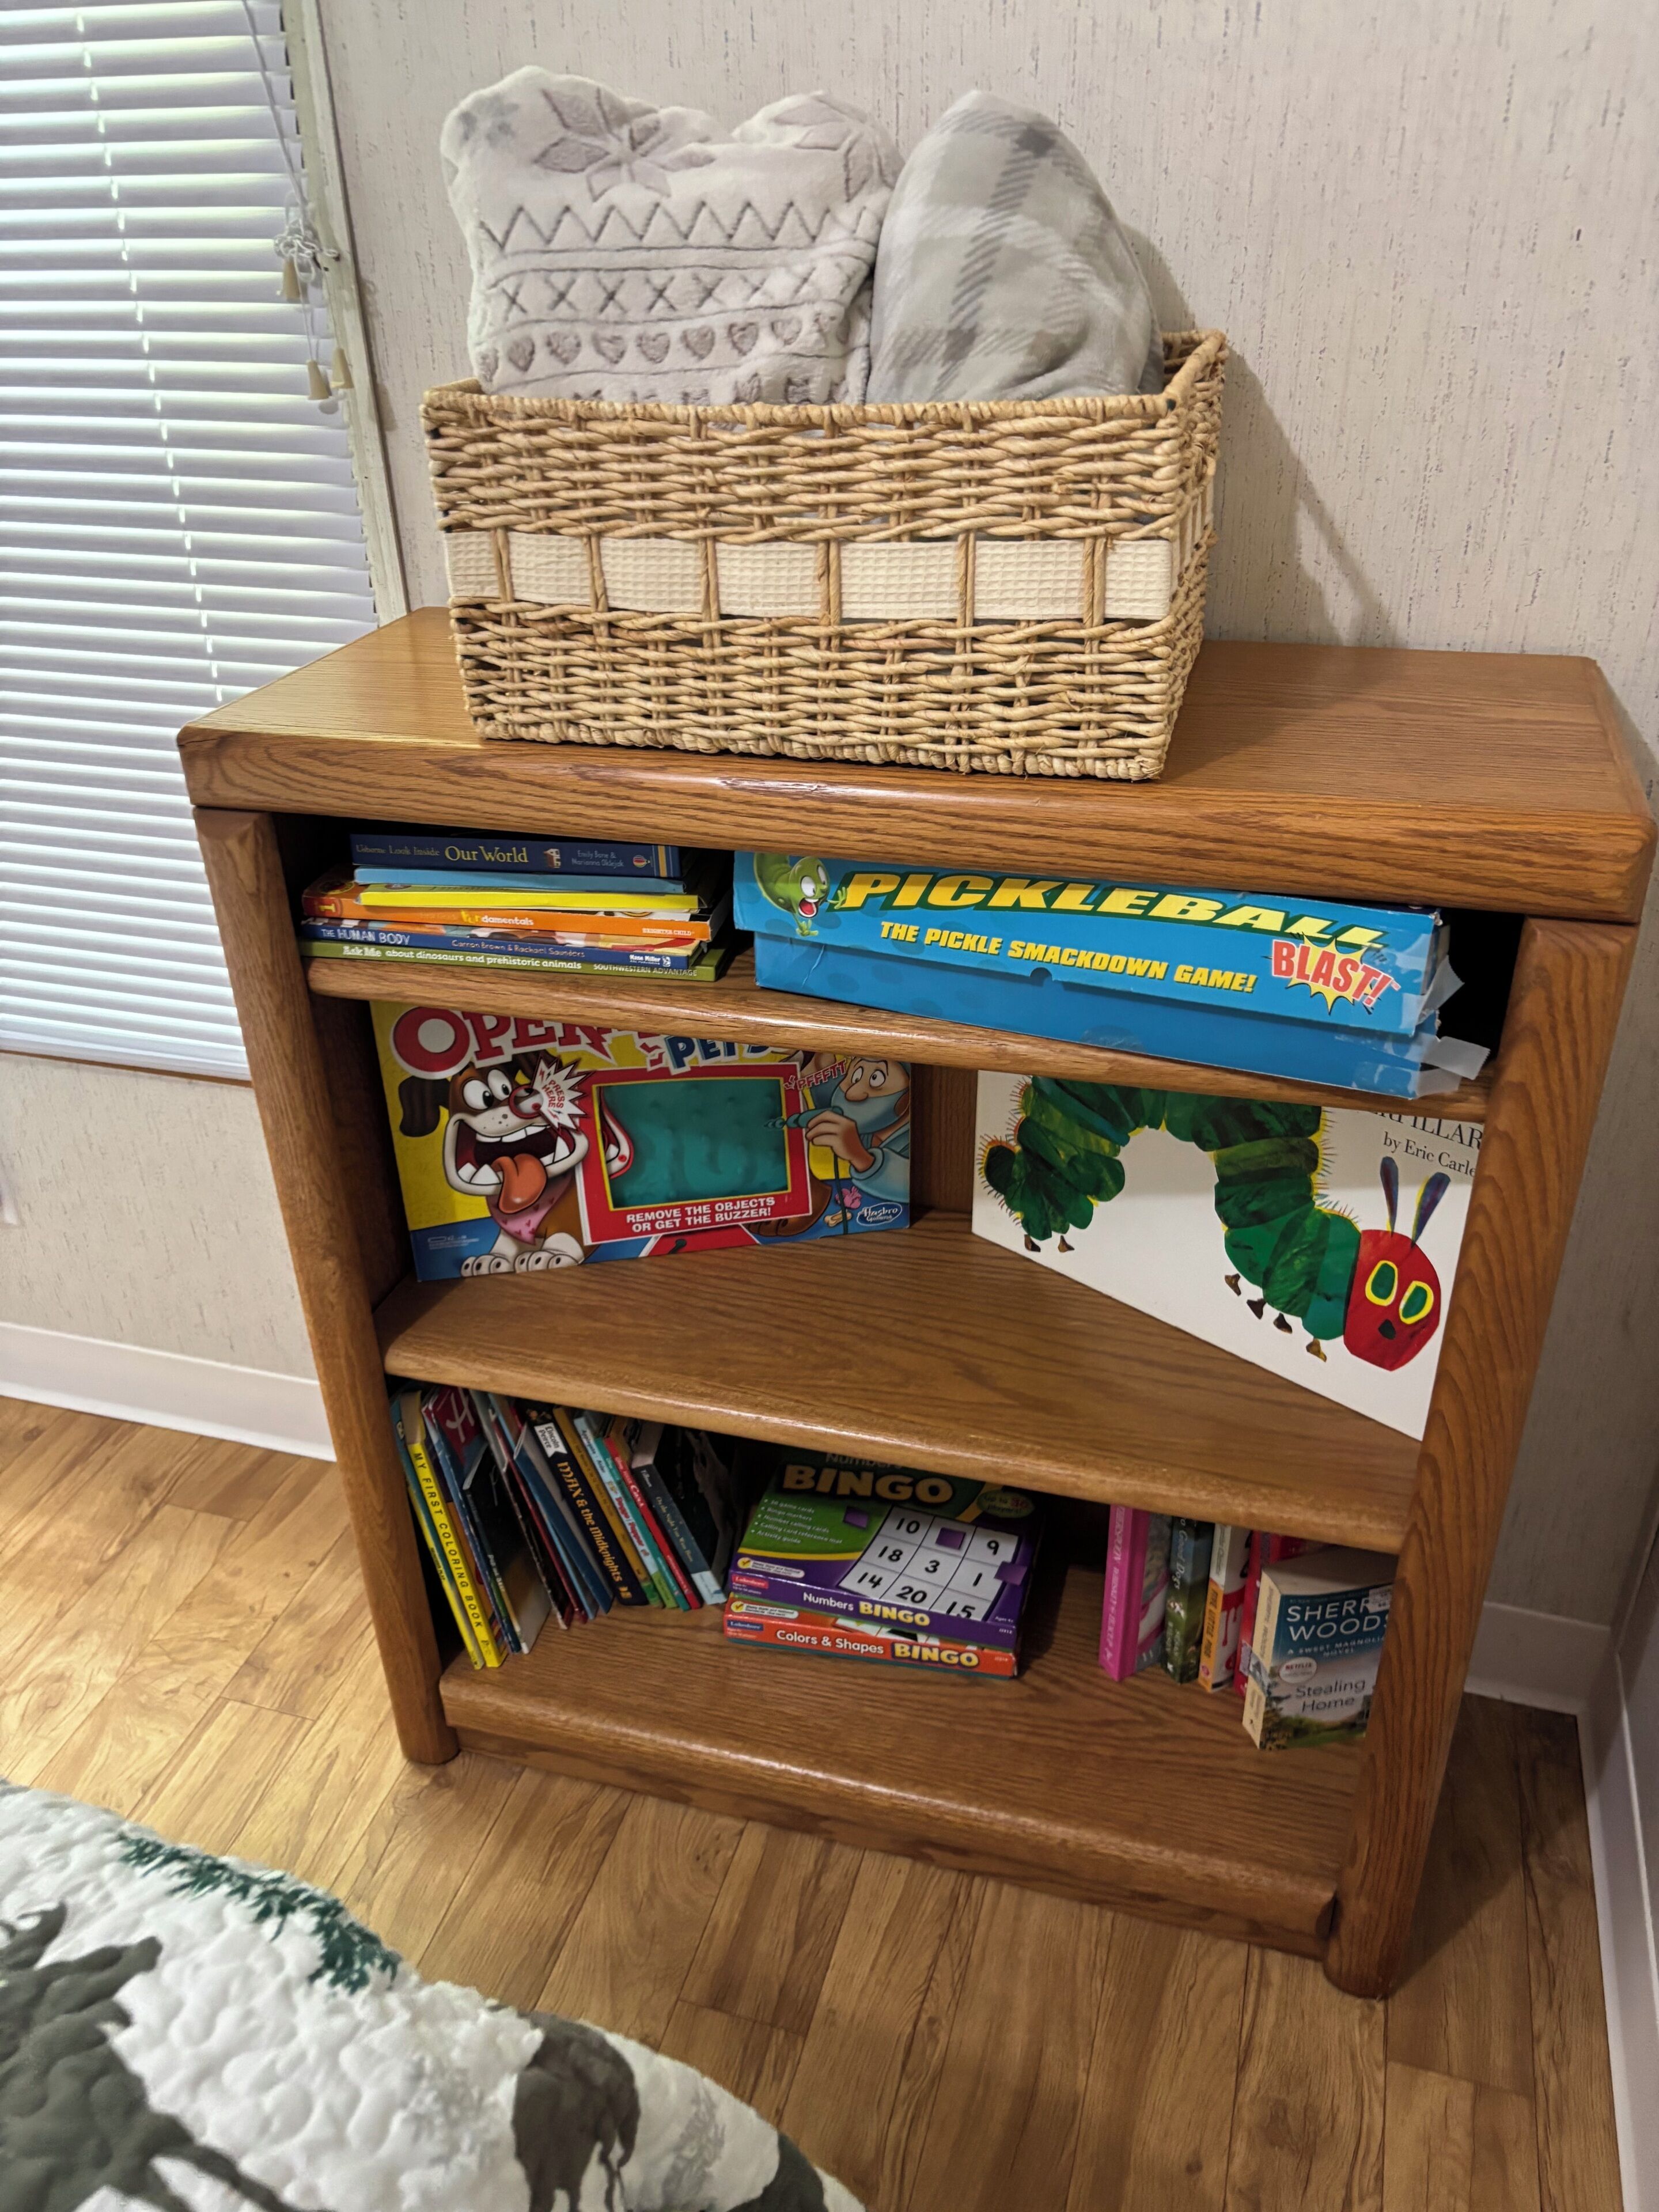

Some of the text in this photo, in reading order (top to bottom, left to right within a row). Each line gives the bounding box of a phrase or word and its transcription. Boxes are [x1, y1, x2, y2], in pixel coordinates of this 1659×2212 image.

[389, 845, 410, 855] Look
[414, 846, 440, 856] Inside
[445, 846, 478, 861] Our
[479, 846, 529, 863] World
[838, 872, 1386, 946] PICKLEBALL
[321, 929, 411, 945] THE HUMAN BODY
[480, 942, 506, 950] Brown
[343, 946, 582, 969] Ask Me about dinosaurs and prehistoric animals
[881, 922, 1258, 993] THE PICKLE SMACKDOWN GAME!
[593, 963, 651, 974] SOUTHWESTERN
[652, 966, 698, 977] ADVANTAGE
[1272, 940, 1395, 1007] BLAST!
[541, 1084, 556, 1108] HERE
[548, 1080, 565, 1109] PRESS
[1383, 1131, 1475, 1177] by Eric Carle
[626, 1196, 775, 1223] REMOVE THE OBJECTS
[859, 1206, 898, 1218] Hasbro
[632, 1207, 771, 1233] OR GET THE BUZZER!
[546, 1426, 560, 1449] Lincoln
[783, 1465, 954, 1503] BINGO
[576, 1499, 588, 1508] &
[581, 1509, 595, 1526] the
[895, 1517, 921, 1535] 10
[414, 1453, 483, 1628] MY FIRST COLORING BOOK
[756, 1530, 782, 1540] Activity
[589, 1527, 622, 1582] Midknights
[878, 1545, 904, 1563] 18
[986, 1539, 1000, 1556] 9
[1177, 1529, 1188, 1562] Good
[924, 1559, 940, 1575] 3
[1172, 1562, 1185, 1590] Dogs
[857, 1571, 882, 1589] 14
[972, 1573, 984, 1588] 1
[896, 1585, 927, 1604] 20
[803, 1592, 931, 1627] Numbers BINGO
[945, 1601, 976, 1619] 15
[776, 1630, 979, 1667] Colors & Shapes BINGO
[1299, 1643, 1330, 1654] SWEET
[1335, 1637, 1384, 1649] MAGNOLI
[1323, 1648, 1354, 1658] NOVEL
[1285, 1662, 1312, 1671] NETFLIX
[1297, 1679, 1366, 1698] Stealing
[1302, 1697, 1355, 1713] Home
